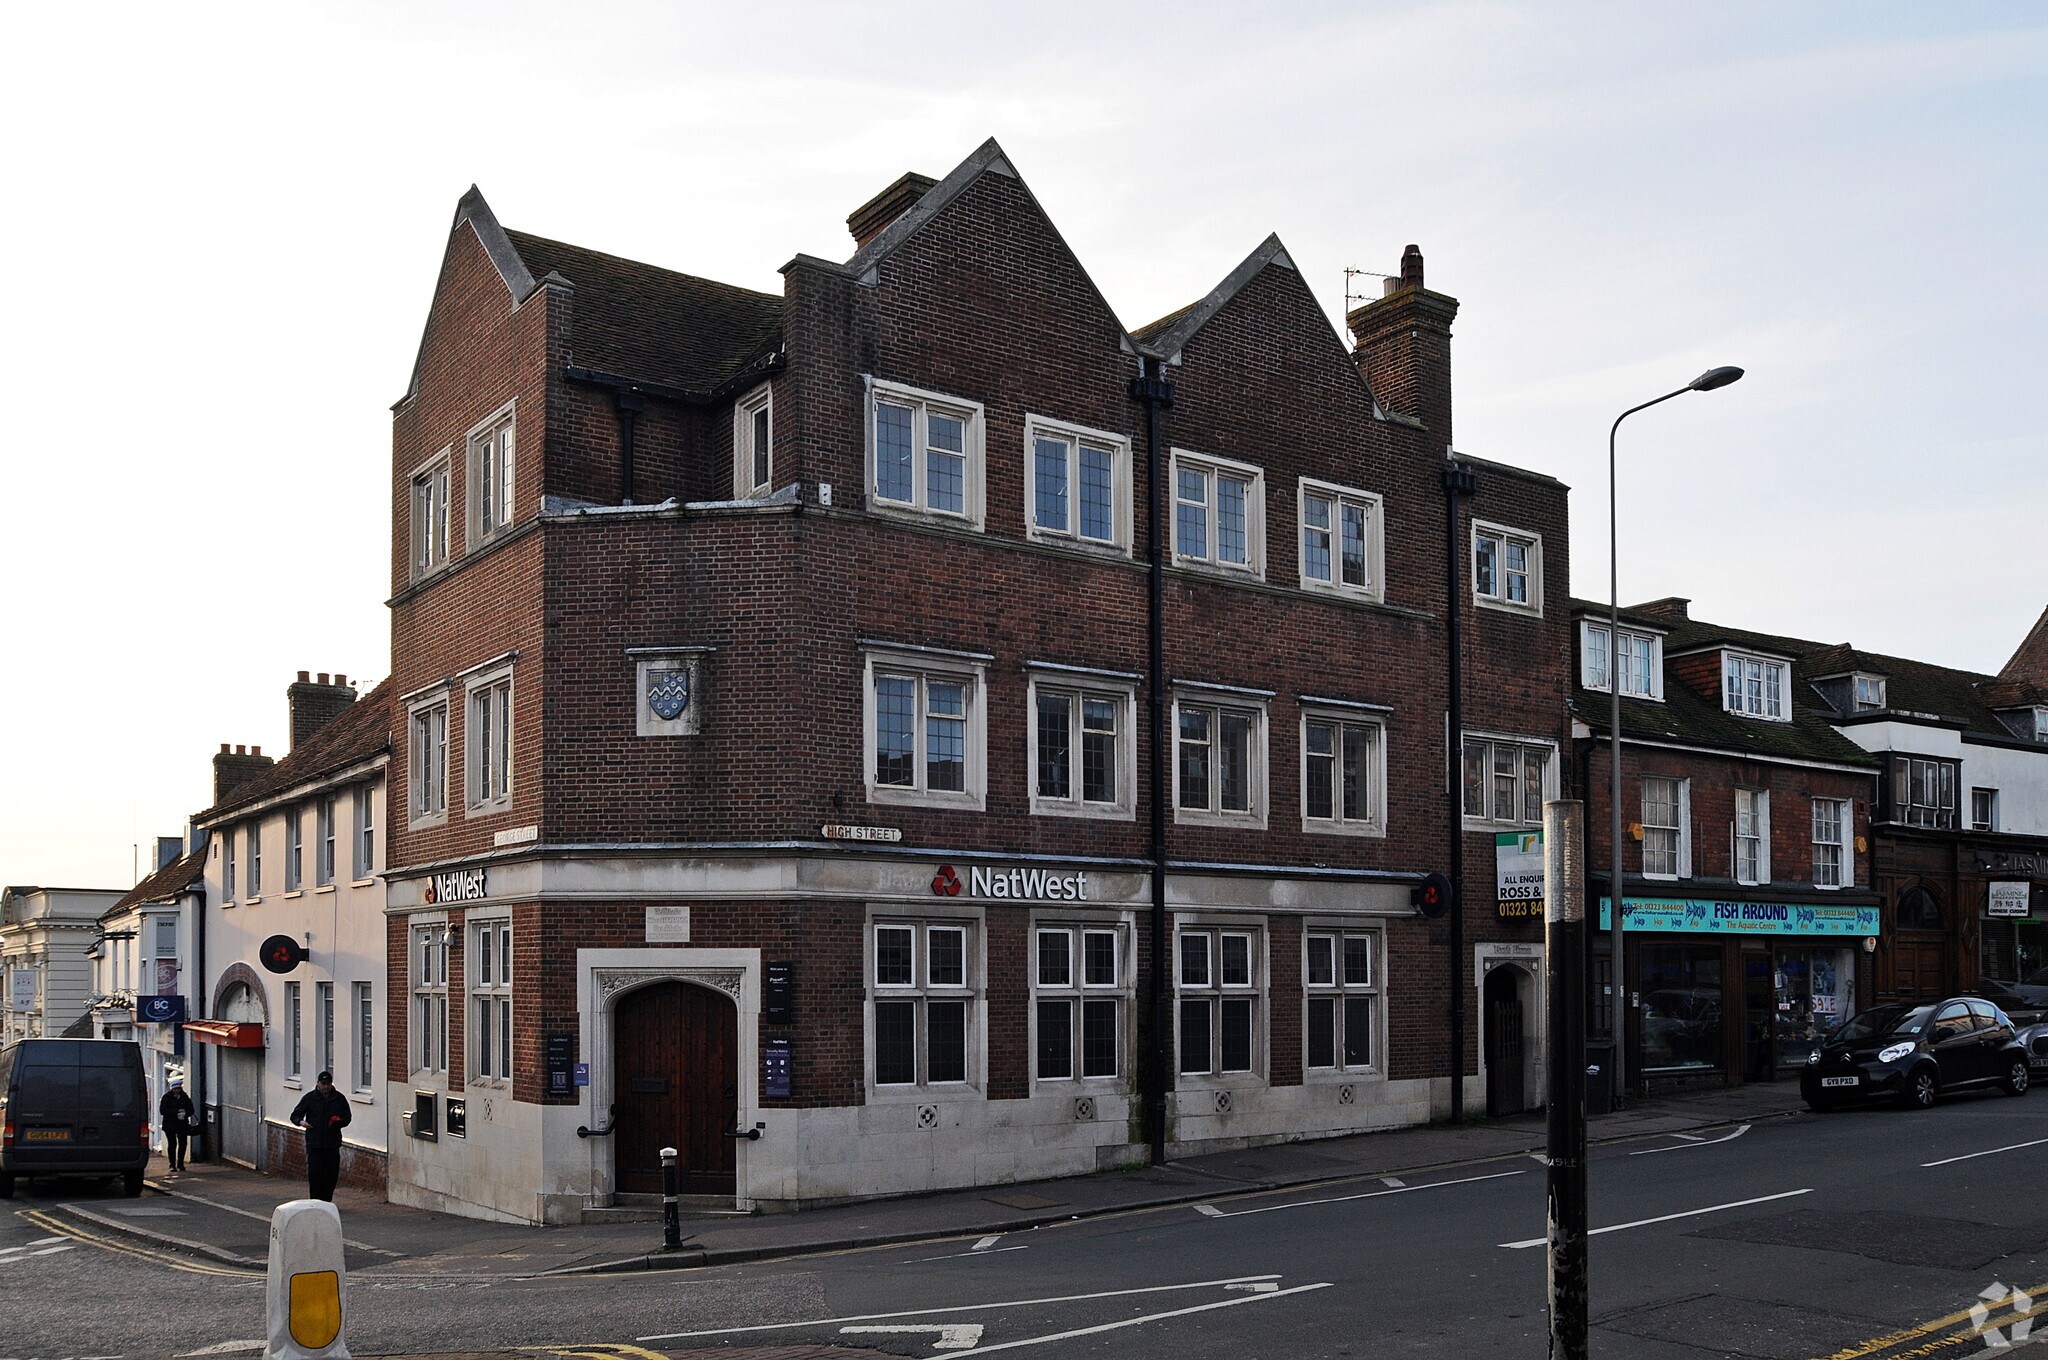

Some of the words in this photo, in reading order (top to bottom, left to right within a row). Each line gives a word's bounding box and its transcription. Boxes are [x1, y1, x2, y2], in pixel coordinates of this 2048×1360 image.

[827, 825, 852, 838] HIGH
[856, 827, 897, 840] STREET
[437, 868, 485, 903] NatWest
[971, 866, 1088, 900] NatWest
[1504, 875, 1518, 885] ALL
[1500, 886, 1531, 899] ROSS
[1532, 886, 1542, 897] &
[1499, 901, 1528, 917] 01323
[1644, 902, 1661, 911] 01323
[1714, 902, 1739, 919] FISH
[1742, 903, 1788, 921] AROUND
[1726, 920, 1737, 928] The
[1738, 921, 1758, 930] Aquatic
[1759, 922, 1777, 930] Centre
[153, 1000, 169, 1010] BC
[1812, 996, 1836, 1012] SALE
[1840, 1077, 1854, 1085] PXO
